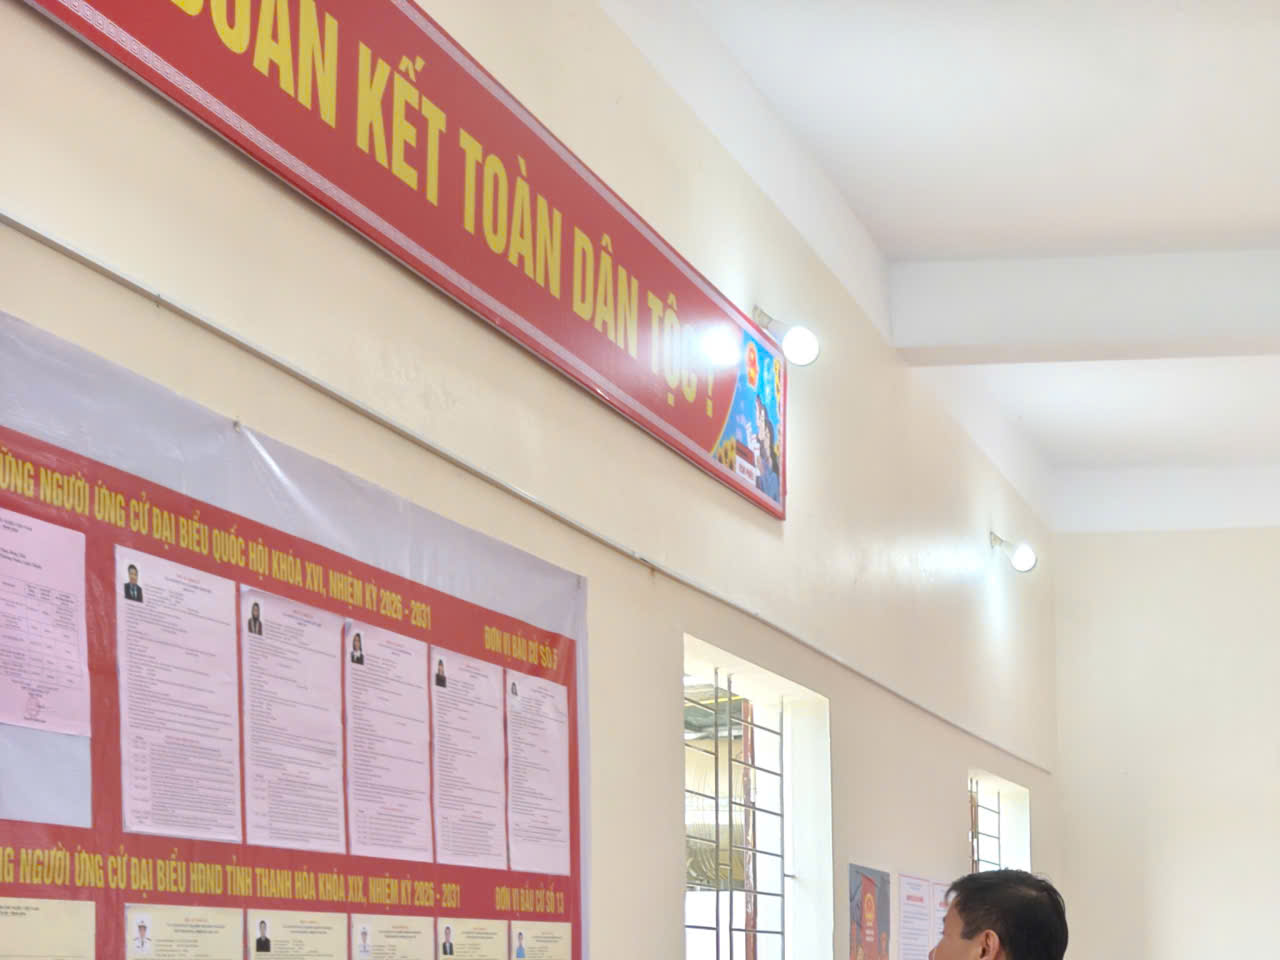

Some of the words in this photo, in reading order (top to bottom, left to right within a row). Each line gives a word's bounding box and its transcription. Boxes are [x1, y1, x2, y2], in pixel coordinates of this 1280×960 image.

[357, 40, 447, 207] KẾT
[459, 127, 562, 300] TOÀN
[572, 225, 639, 360] DÂN
[647, 289, 697, 408] TỘC
[39, 471, 89, 517] NGƯỜI
[94, 480, 126, 528] ỨNG
[129, 491, 150, 536] CỬ
[152, 506, 176, 549] ĐẠI
[178, 509, 209, 556] BIỂU
[212, 524, 245, 567] QUỐC
[248, 537, 269, 581] HỘI
[271, 549, 303, 588] KHÓA
[329, 569, 363, 609] NHIỆM
[365, 579, 379, 611] KỲ
[20, 842, 70, 886] NGƯỜI
[74, 845, 104, 888] ỨNG
[108, 844, 128, 889] CỬ
[130, 857, 153, 898] ĐẠI
[156, 848, 187, 892] BIỂU
[255, 867, 292, 898] THANH
